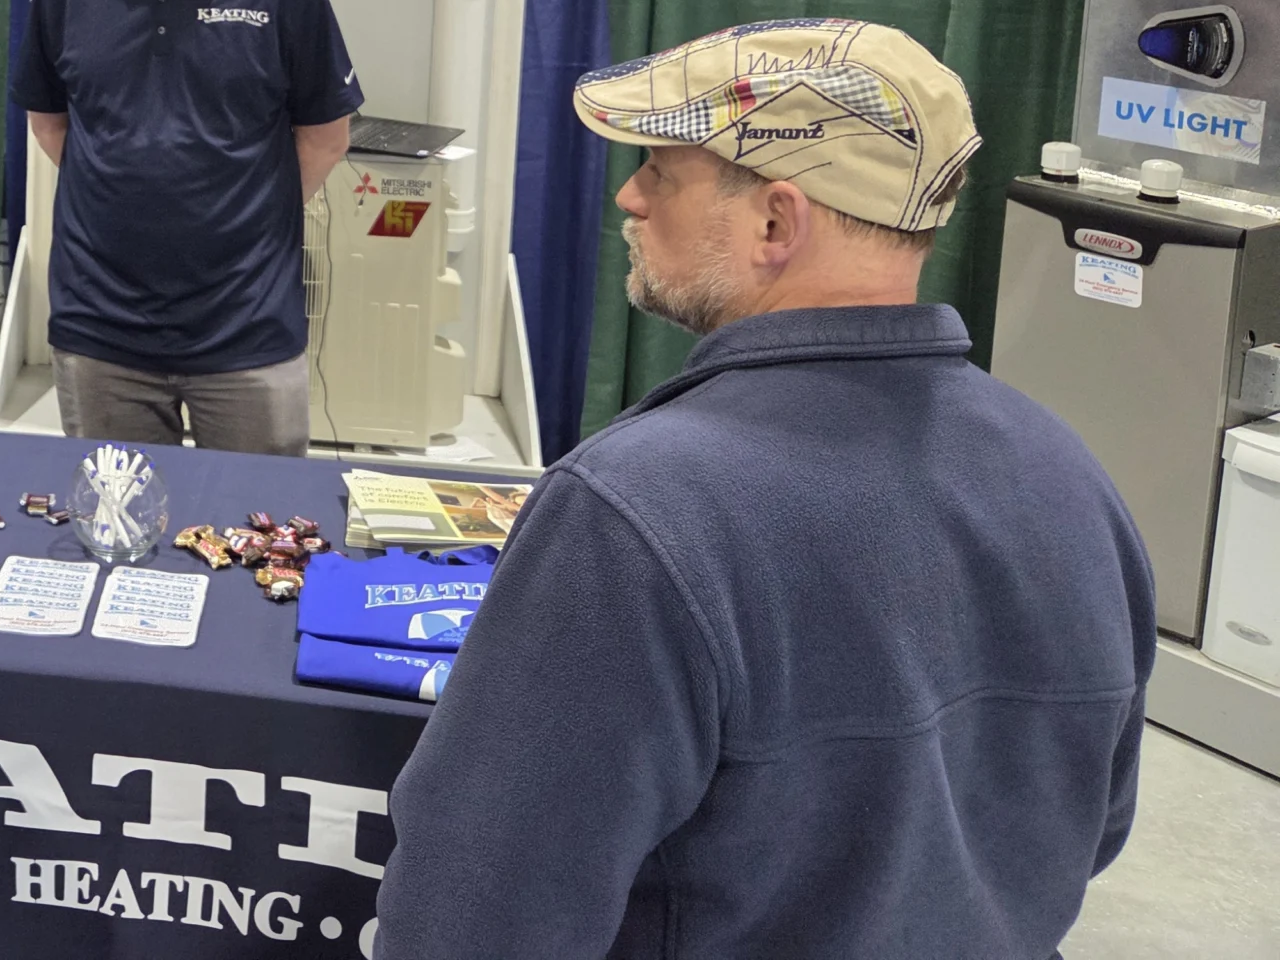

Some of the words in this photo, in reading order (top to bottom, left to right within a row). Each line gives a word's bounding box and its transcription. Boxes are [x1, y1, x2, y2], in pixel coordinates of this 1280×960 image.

[197, 7, 270, 24] KEATING
[1115, 99, 1157, 124] UV
[1163, 107, 1249, 141] LIGHT
[381, 178, 432, 189] MITSUBISHI
[381, 187, 425, 197] ELECTRIC
[1082, 233, 1124, 250] LENNOX
[1081, 255, 1137, 274] KEATING
[122, 568, 199, 582] KEATING
[4, 584, 81, 598] KEATING
[116, 584, 195, 601] KEATING
[111, 594, 191, 609] KEATING
[108, 603, 190, 618] KEATING
[10, 856, 305, 941] HEATING
